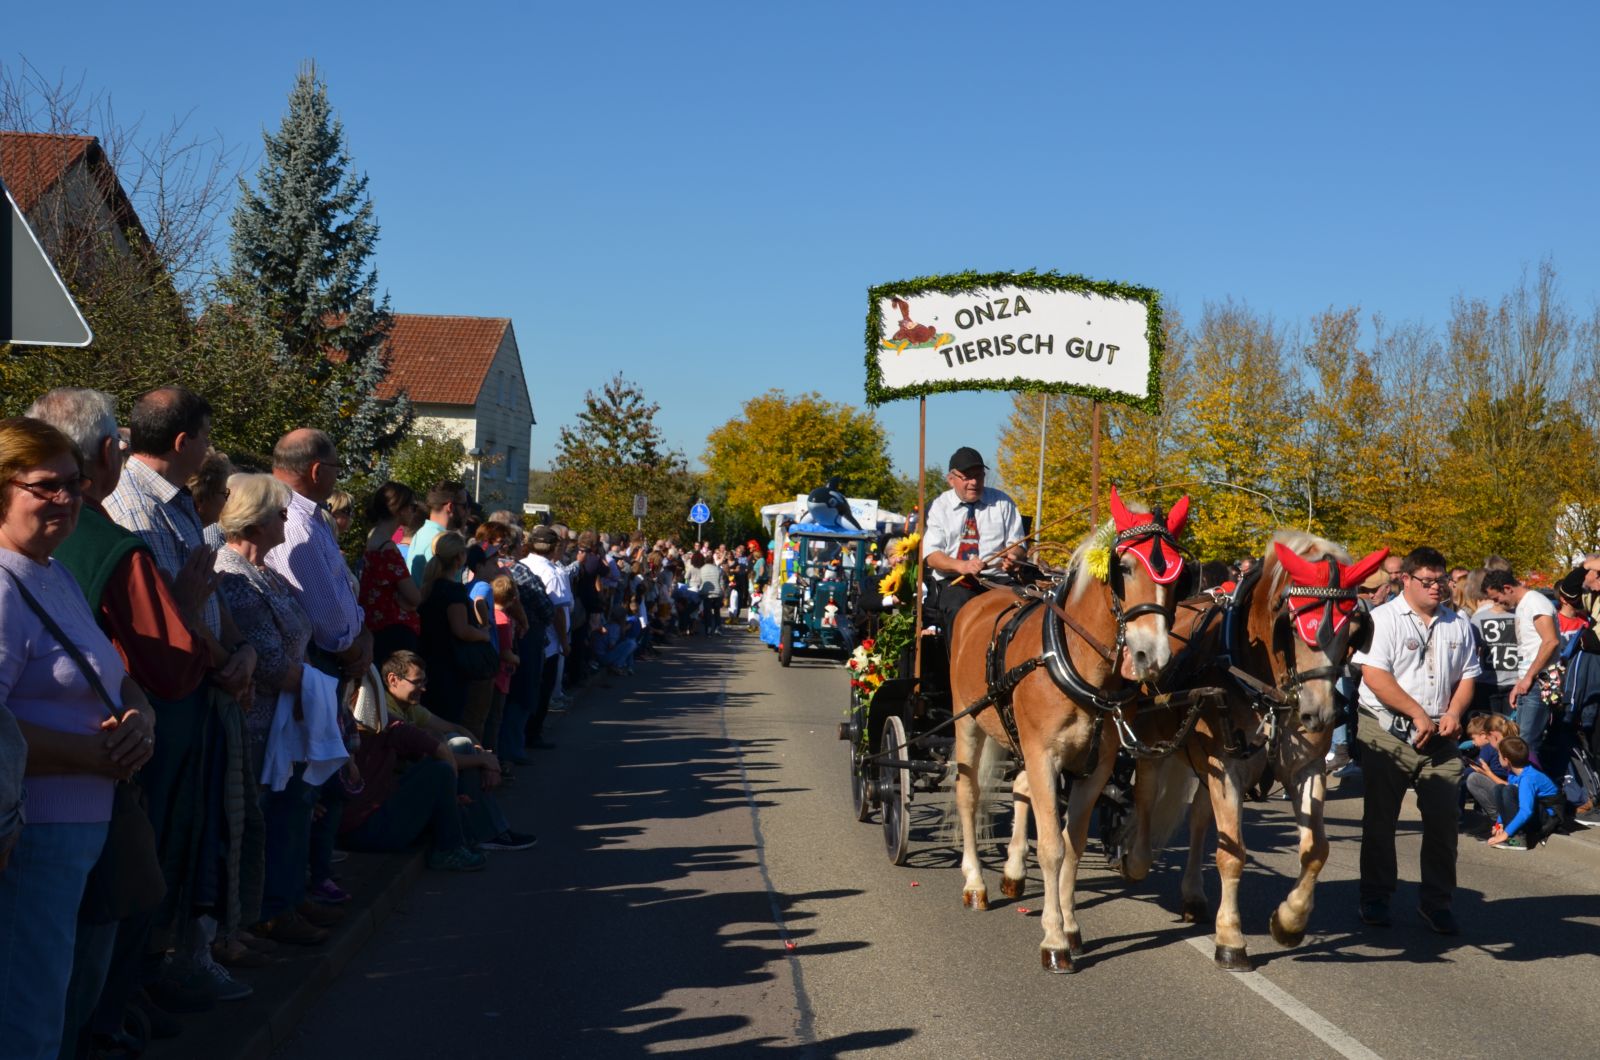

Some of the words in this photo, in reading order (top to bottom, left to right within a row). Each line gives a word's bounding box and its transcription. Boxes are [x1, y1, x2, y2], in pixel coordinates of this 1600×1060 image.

[955, 295, 1031, 330] ONZA
[938, 334, 1054, 368] TIERISCH
[1065, 337, 1120, 365] GUT
